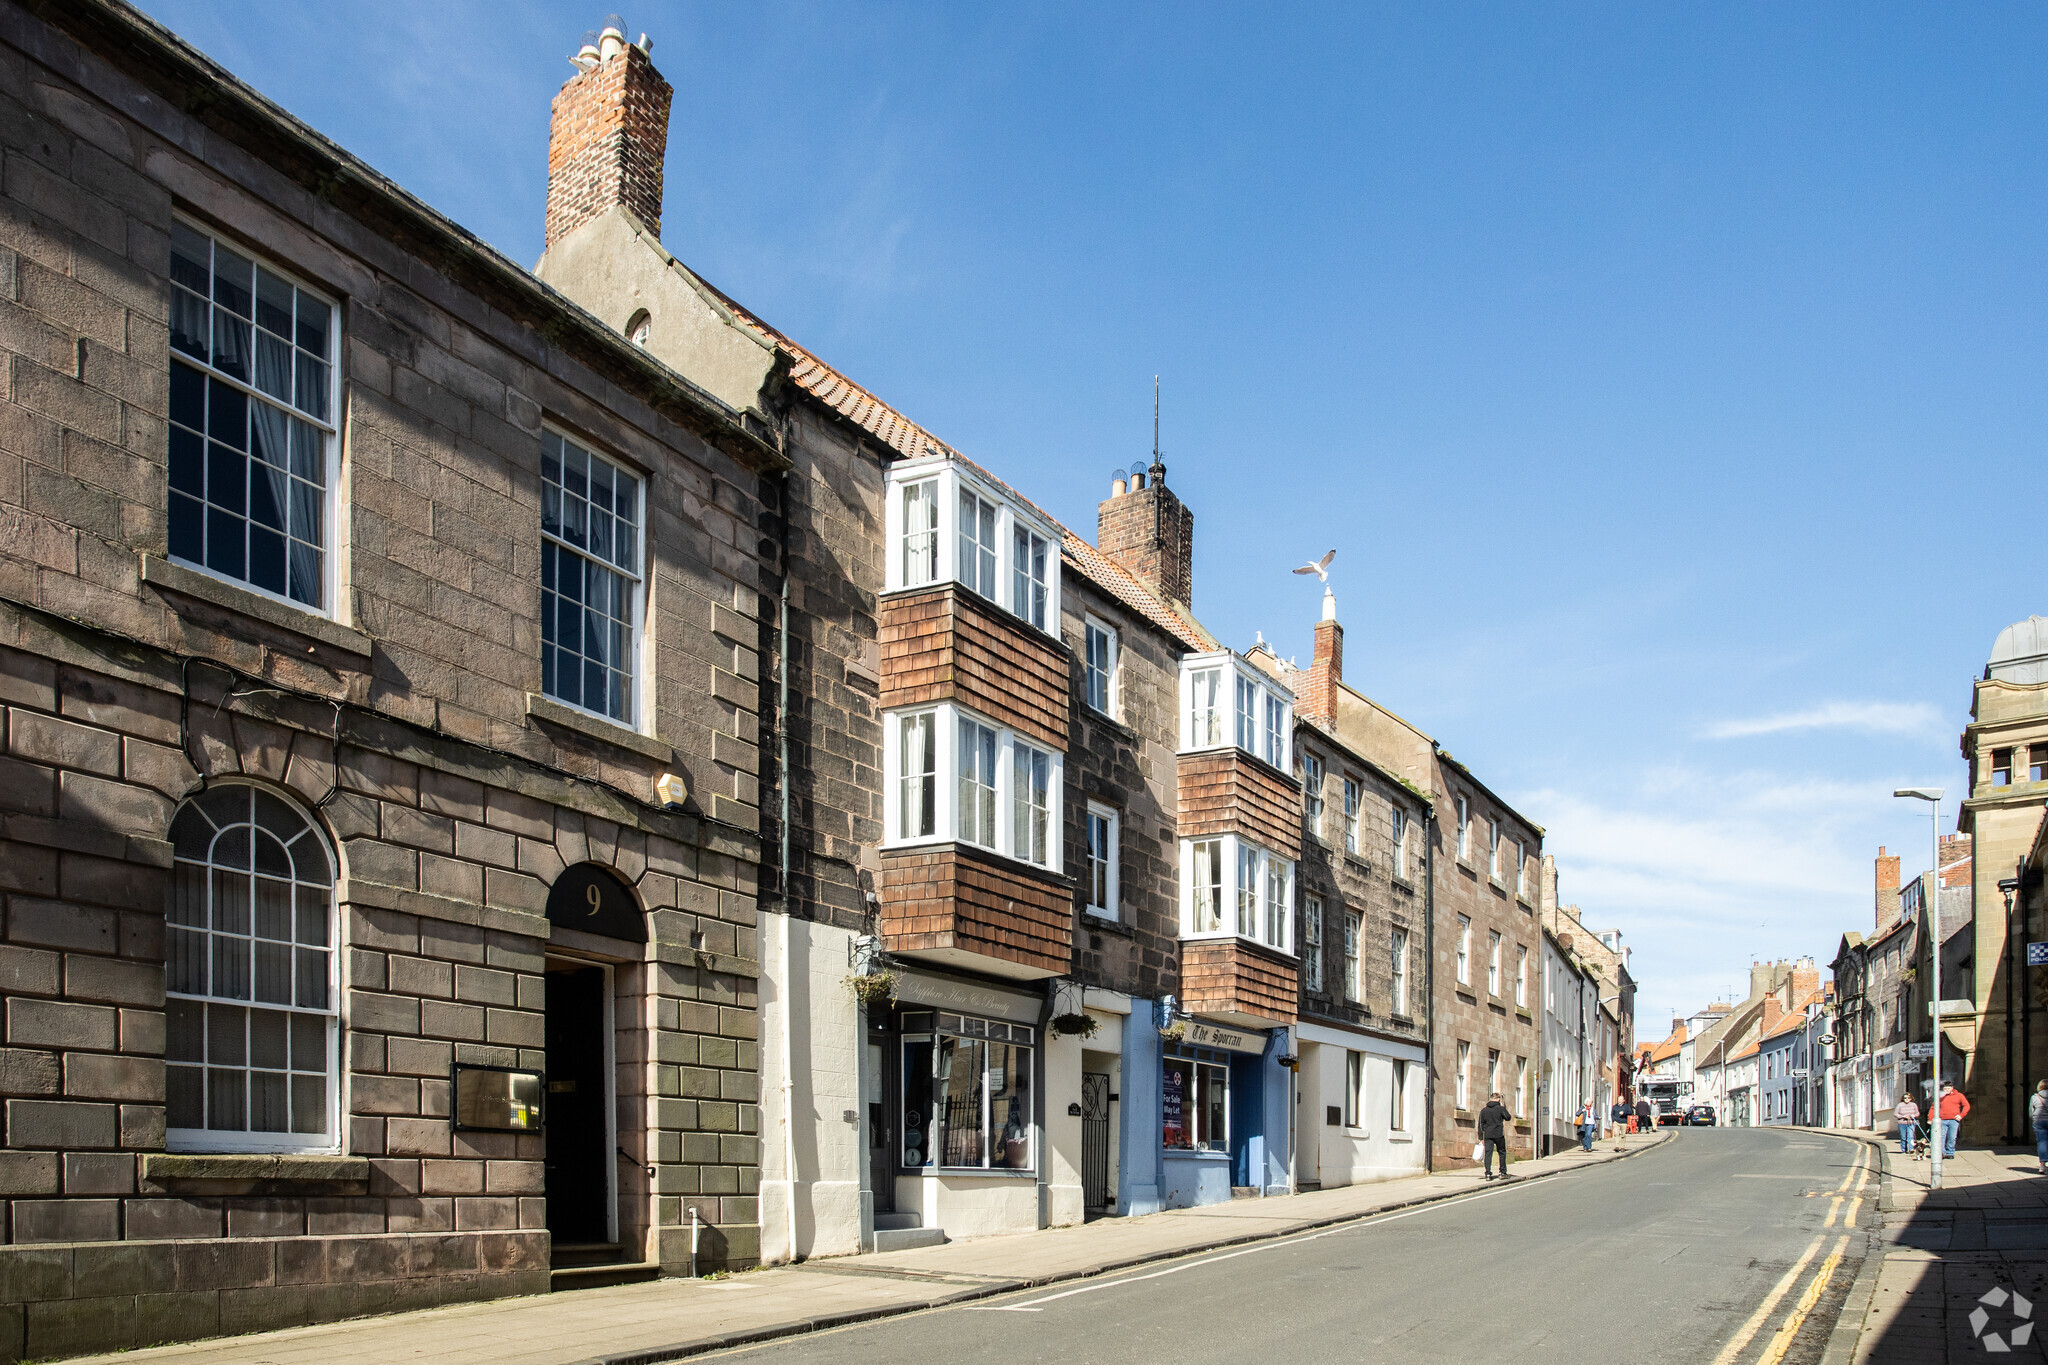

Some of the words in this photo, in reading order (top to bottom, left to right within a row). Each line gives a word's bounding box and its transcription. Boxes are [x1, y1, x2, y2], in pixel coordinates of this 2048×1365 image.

[586, 884, 601, 916] 9
[907, 981, 944, 1001] Sapphire
[944, 987, 968, 1004] Hair
[981, 994, 1010, 1016] Beauty
[1192, 1024, 1208, 1041] The
[1212, 1029, 1242, 1047] Sporran
[1163, 1094, 1171, 1103] For
[1171, 1094, 1181, 1104] Sale
